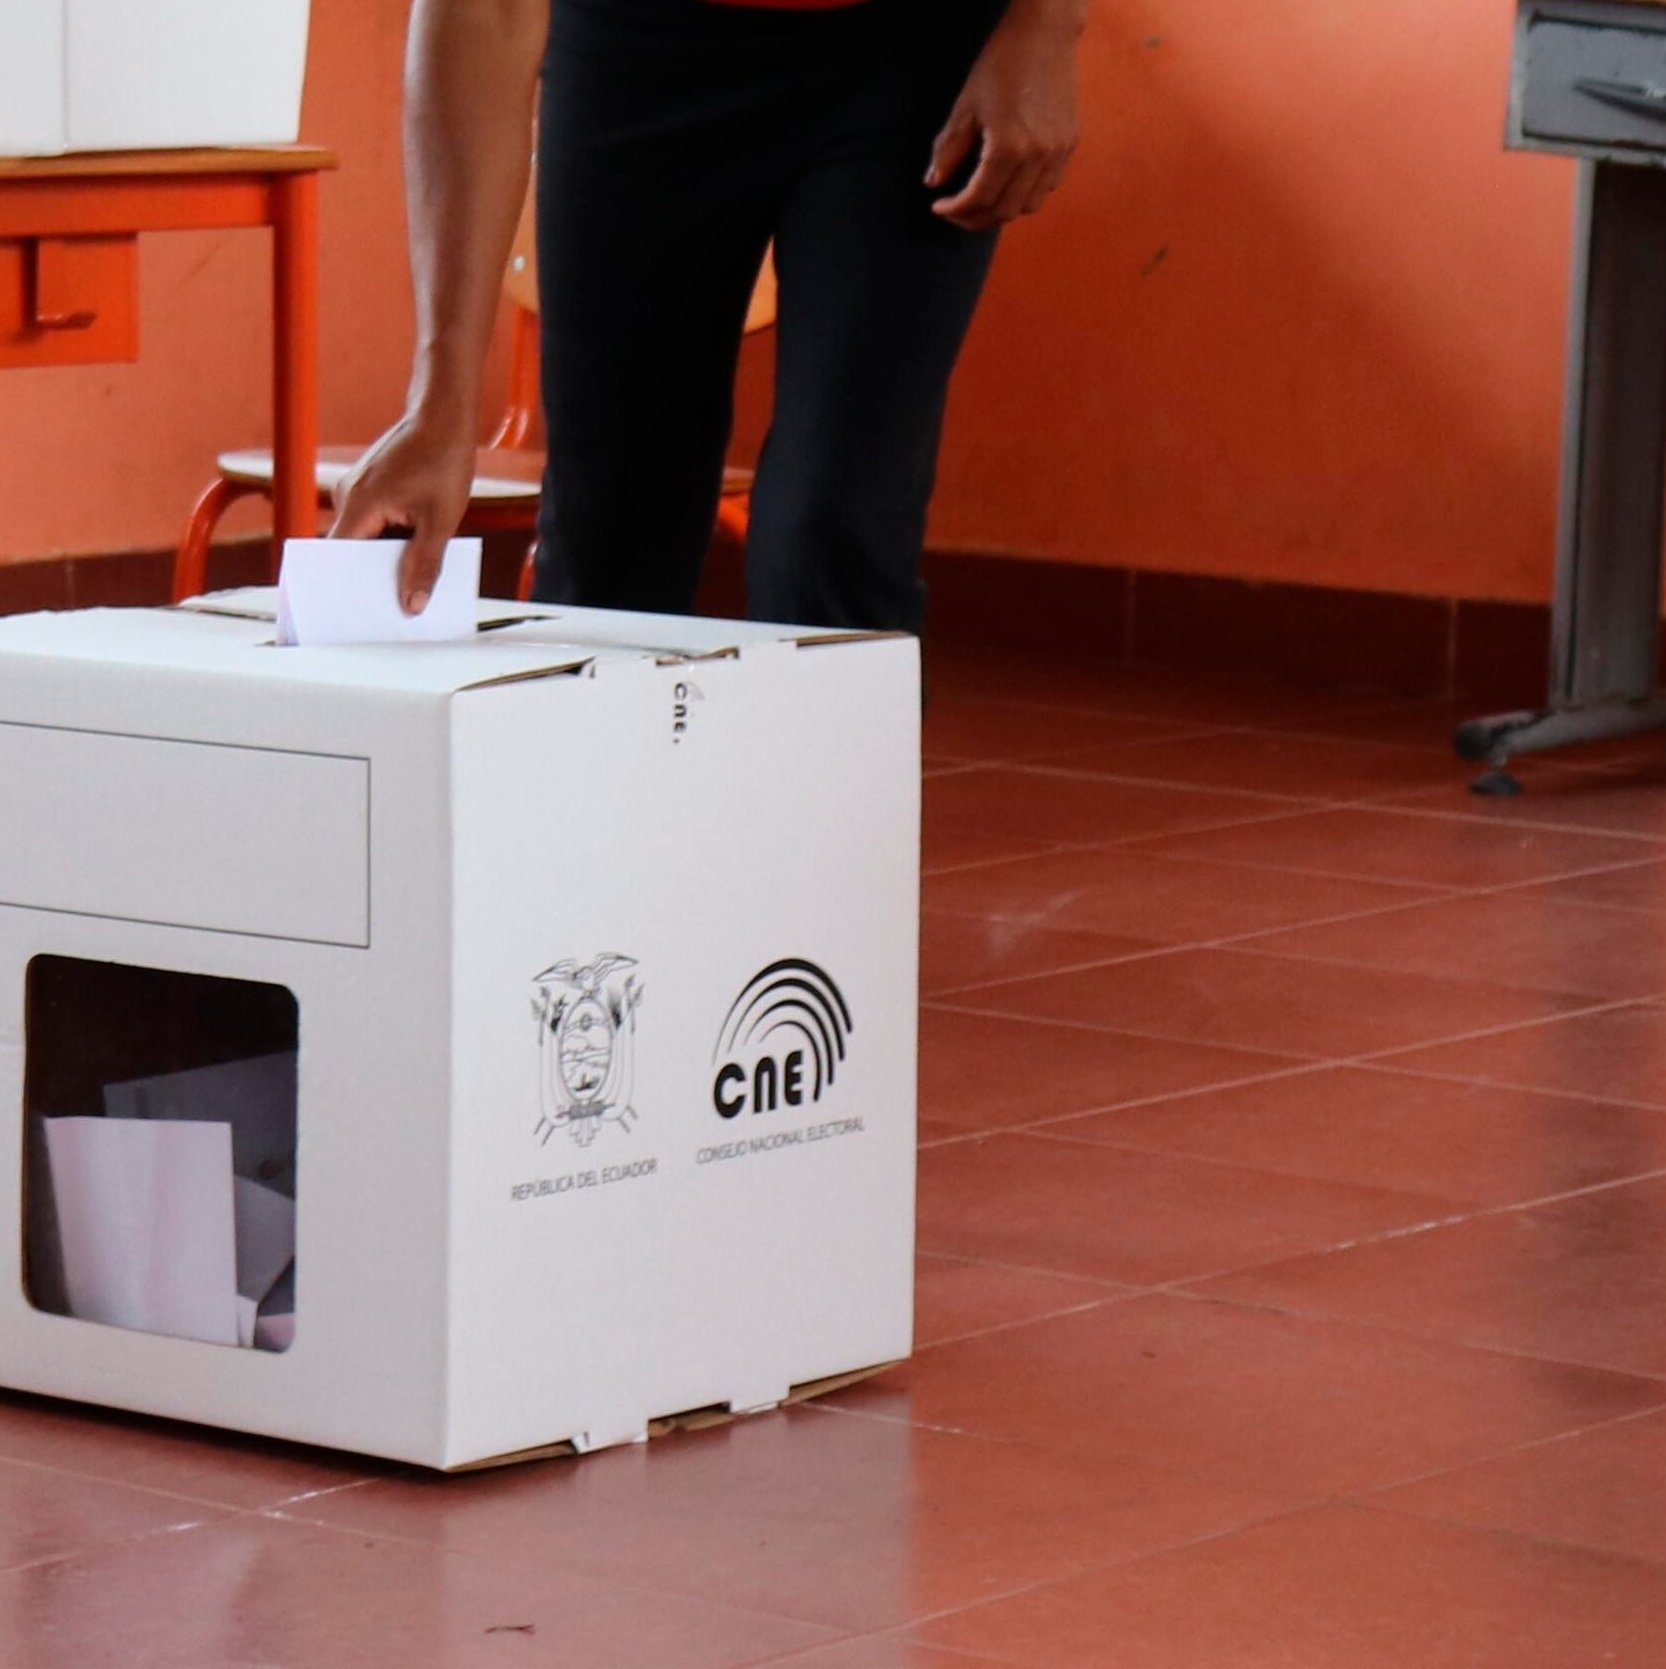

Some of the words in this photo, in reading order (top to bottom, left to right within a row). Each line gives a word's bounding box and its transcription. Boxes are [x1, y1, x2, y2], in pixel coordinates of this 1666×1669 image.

[696, 1141, 747, 1165] CONSEJO
[750, 1130, 802, 1153] NACIONAL
[807, 1117, 865, 1142] ELECTORAL
[577, 1169, 598, 1189] DEL
[601, 1158, 658, 1184] ECUADOR
